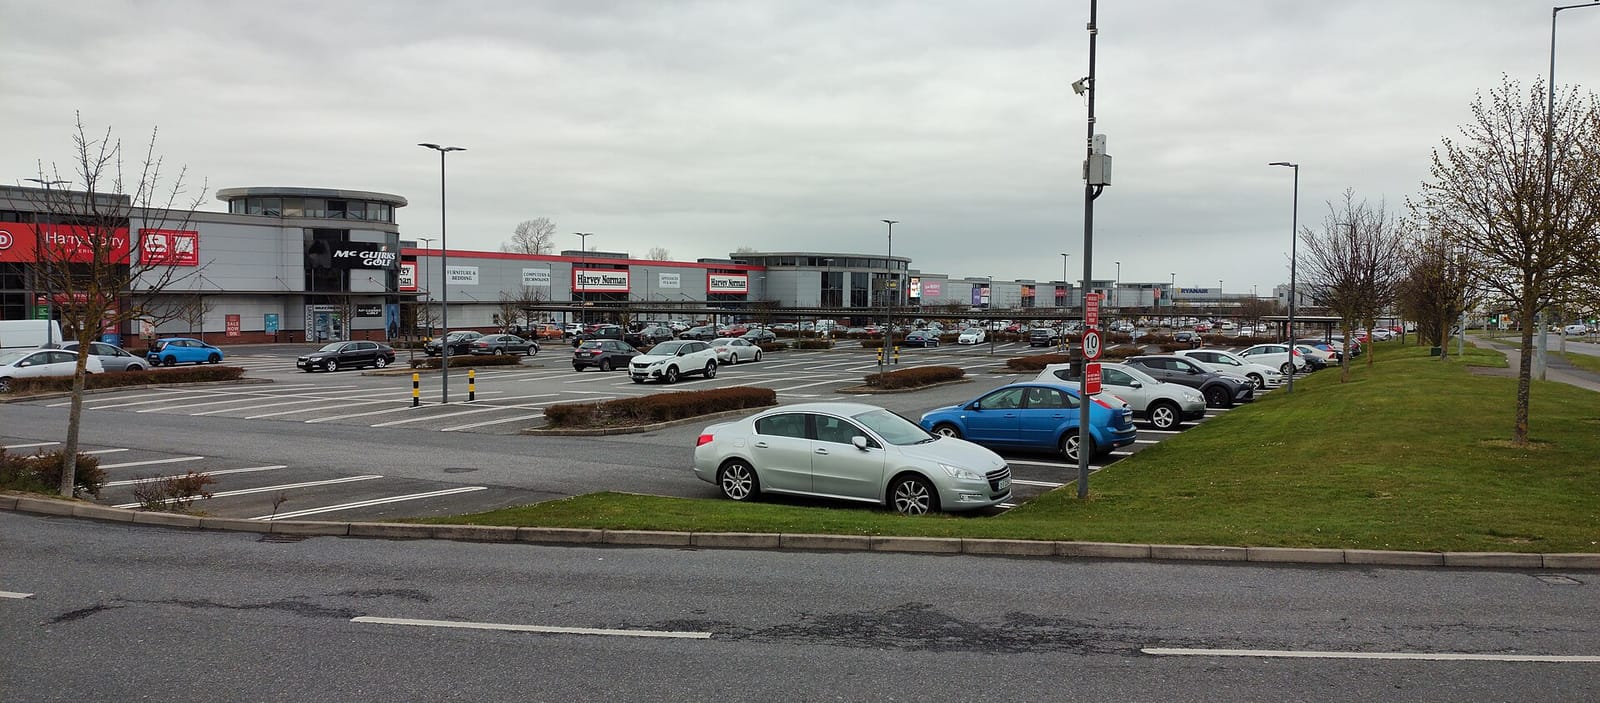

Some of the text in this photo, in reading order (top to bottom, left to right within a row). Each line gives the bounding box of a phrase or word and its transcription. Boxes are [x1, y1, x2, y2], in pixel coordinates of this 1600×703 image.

[45, 232, 124, 249] Harry Cory
[359, 251, 396, 260] GUIRKS
[577, 274, 626, 286] Harvey Norman
[711, 278, 746, 288] Harvey Norman
[1086, 335, 1097, 348] 10
